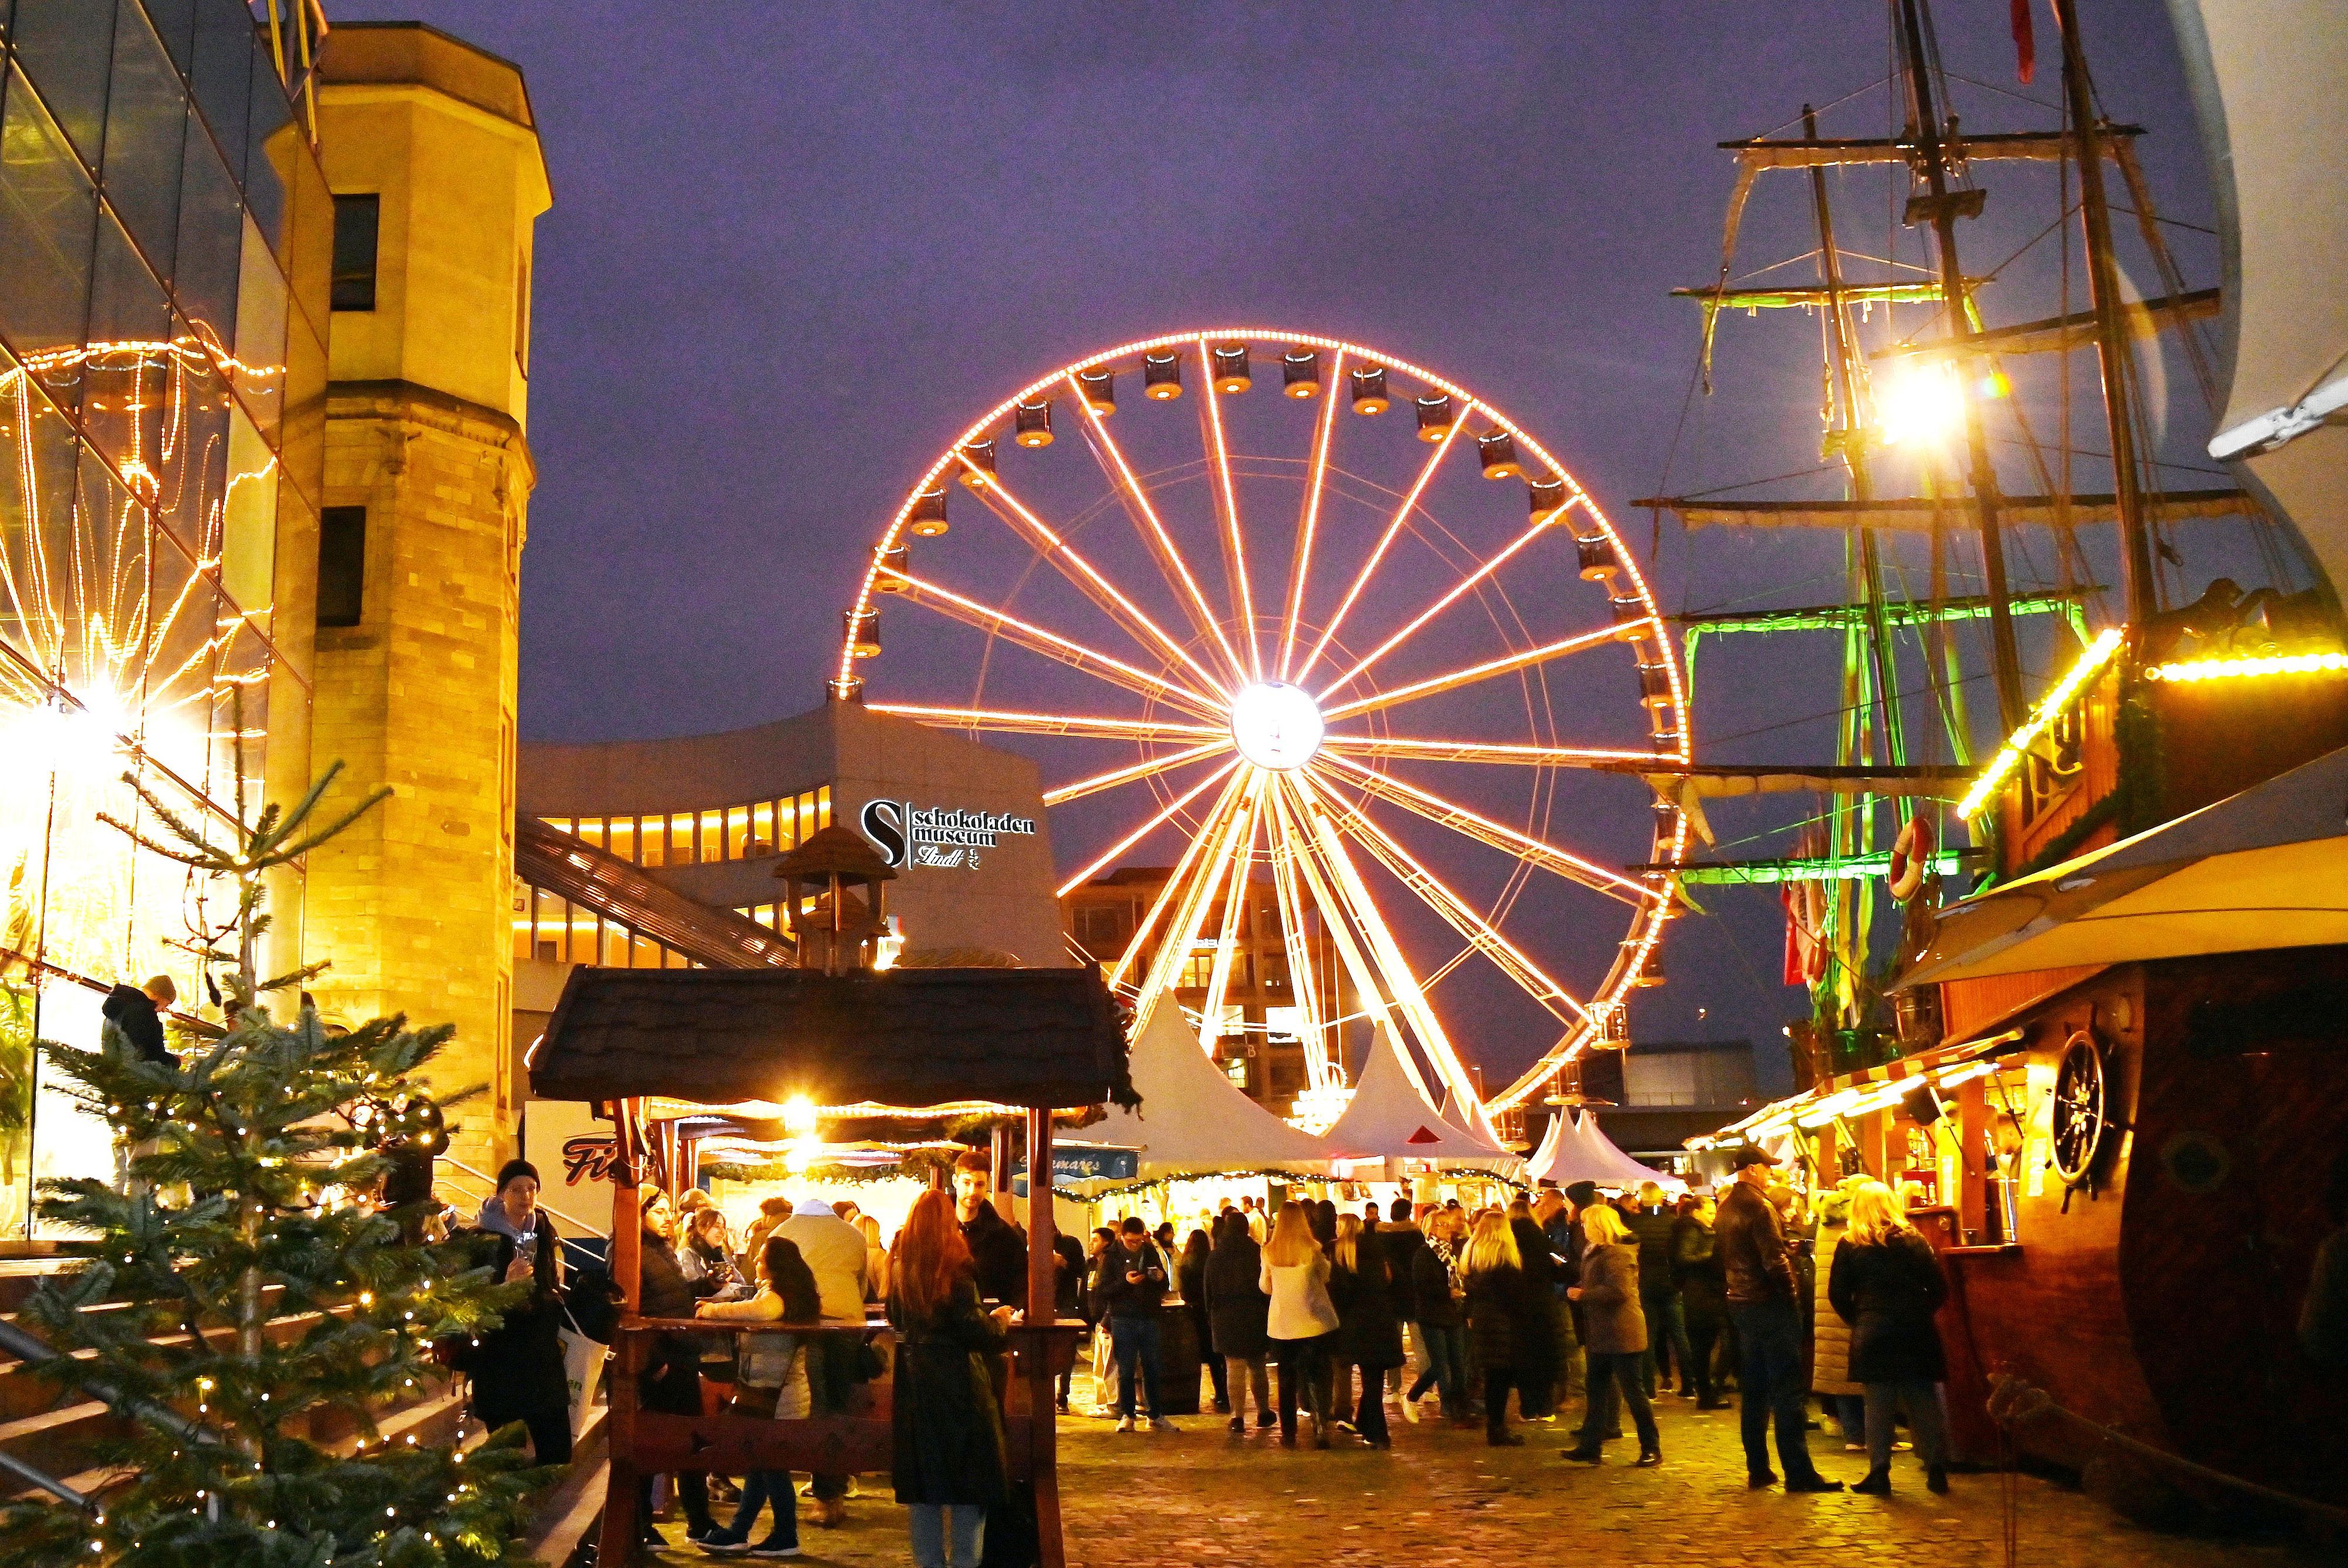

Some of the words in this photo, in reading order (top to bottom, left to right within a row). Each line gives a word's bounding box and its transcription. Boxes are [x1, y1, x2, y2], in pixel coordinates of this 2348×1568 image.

[912, 807, 1035, 835] schokoladen
[912, 827, 997, 847] museum
[914, 845, 964, 867] Lindt
